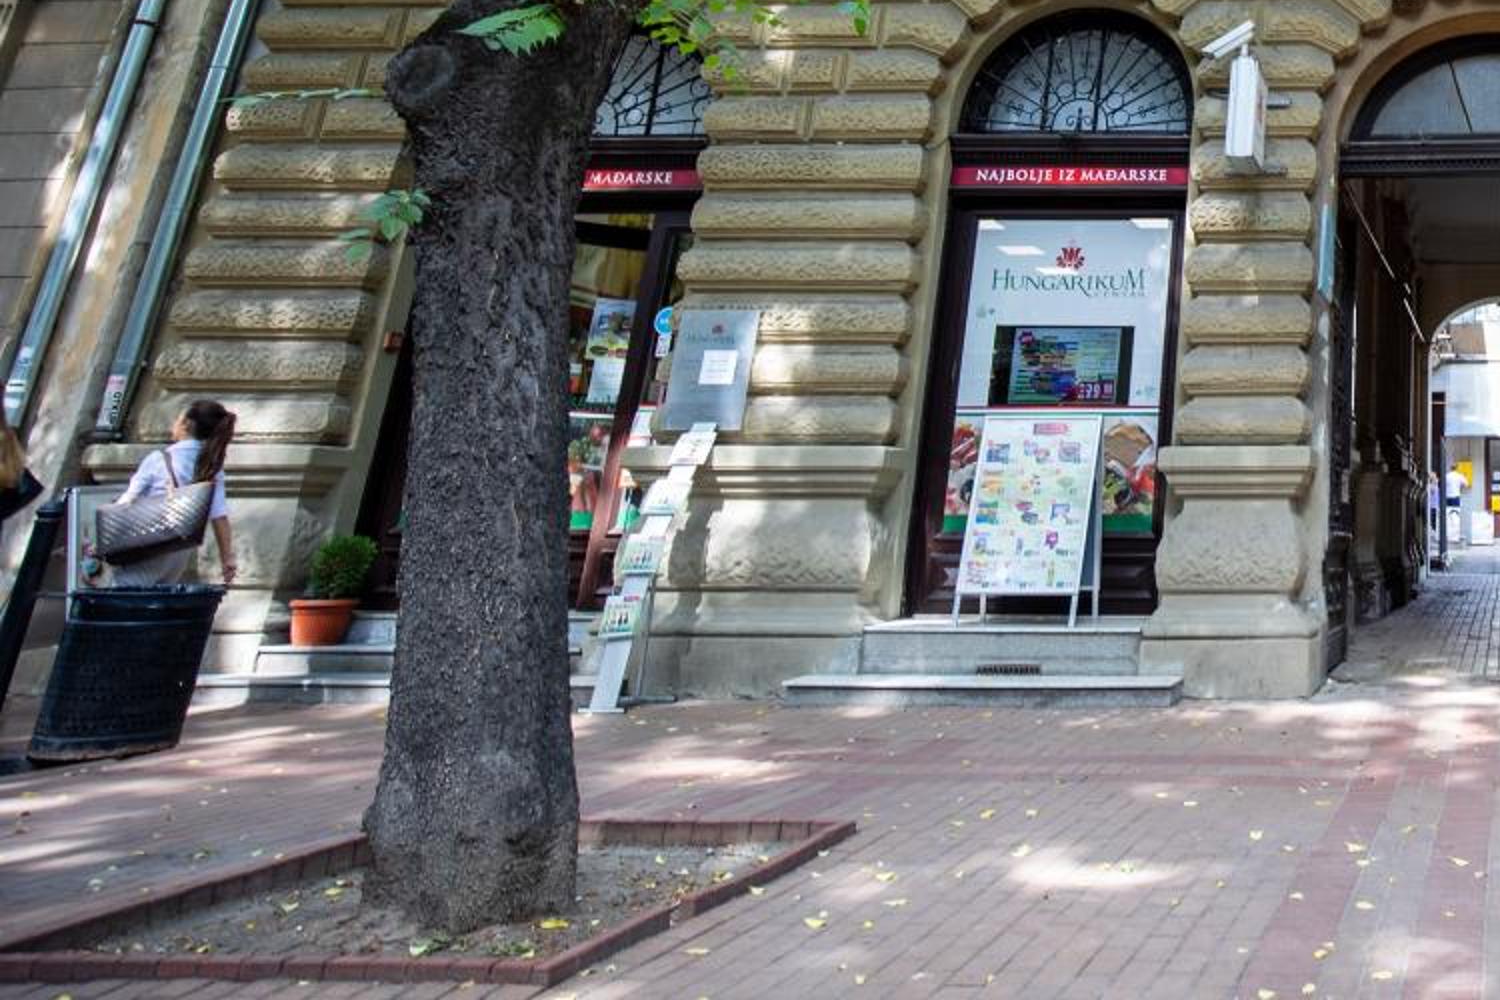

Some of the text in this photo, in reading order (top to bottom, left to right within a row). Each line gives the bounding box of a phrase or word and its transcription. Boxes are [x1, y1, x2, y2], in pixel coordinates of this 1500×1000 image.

[590, 171, 673, 185] MAĐARSKE
[976, 169, 1167, 183] NAJBOLJE IZ MAĐARSKE
[991, 268, 1145, 297] HUNGARIKUM
